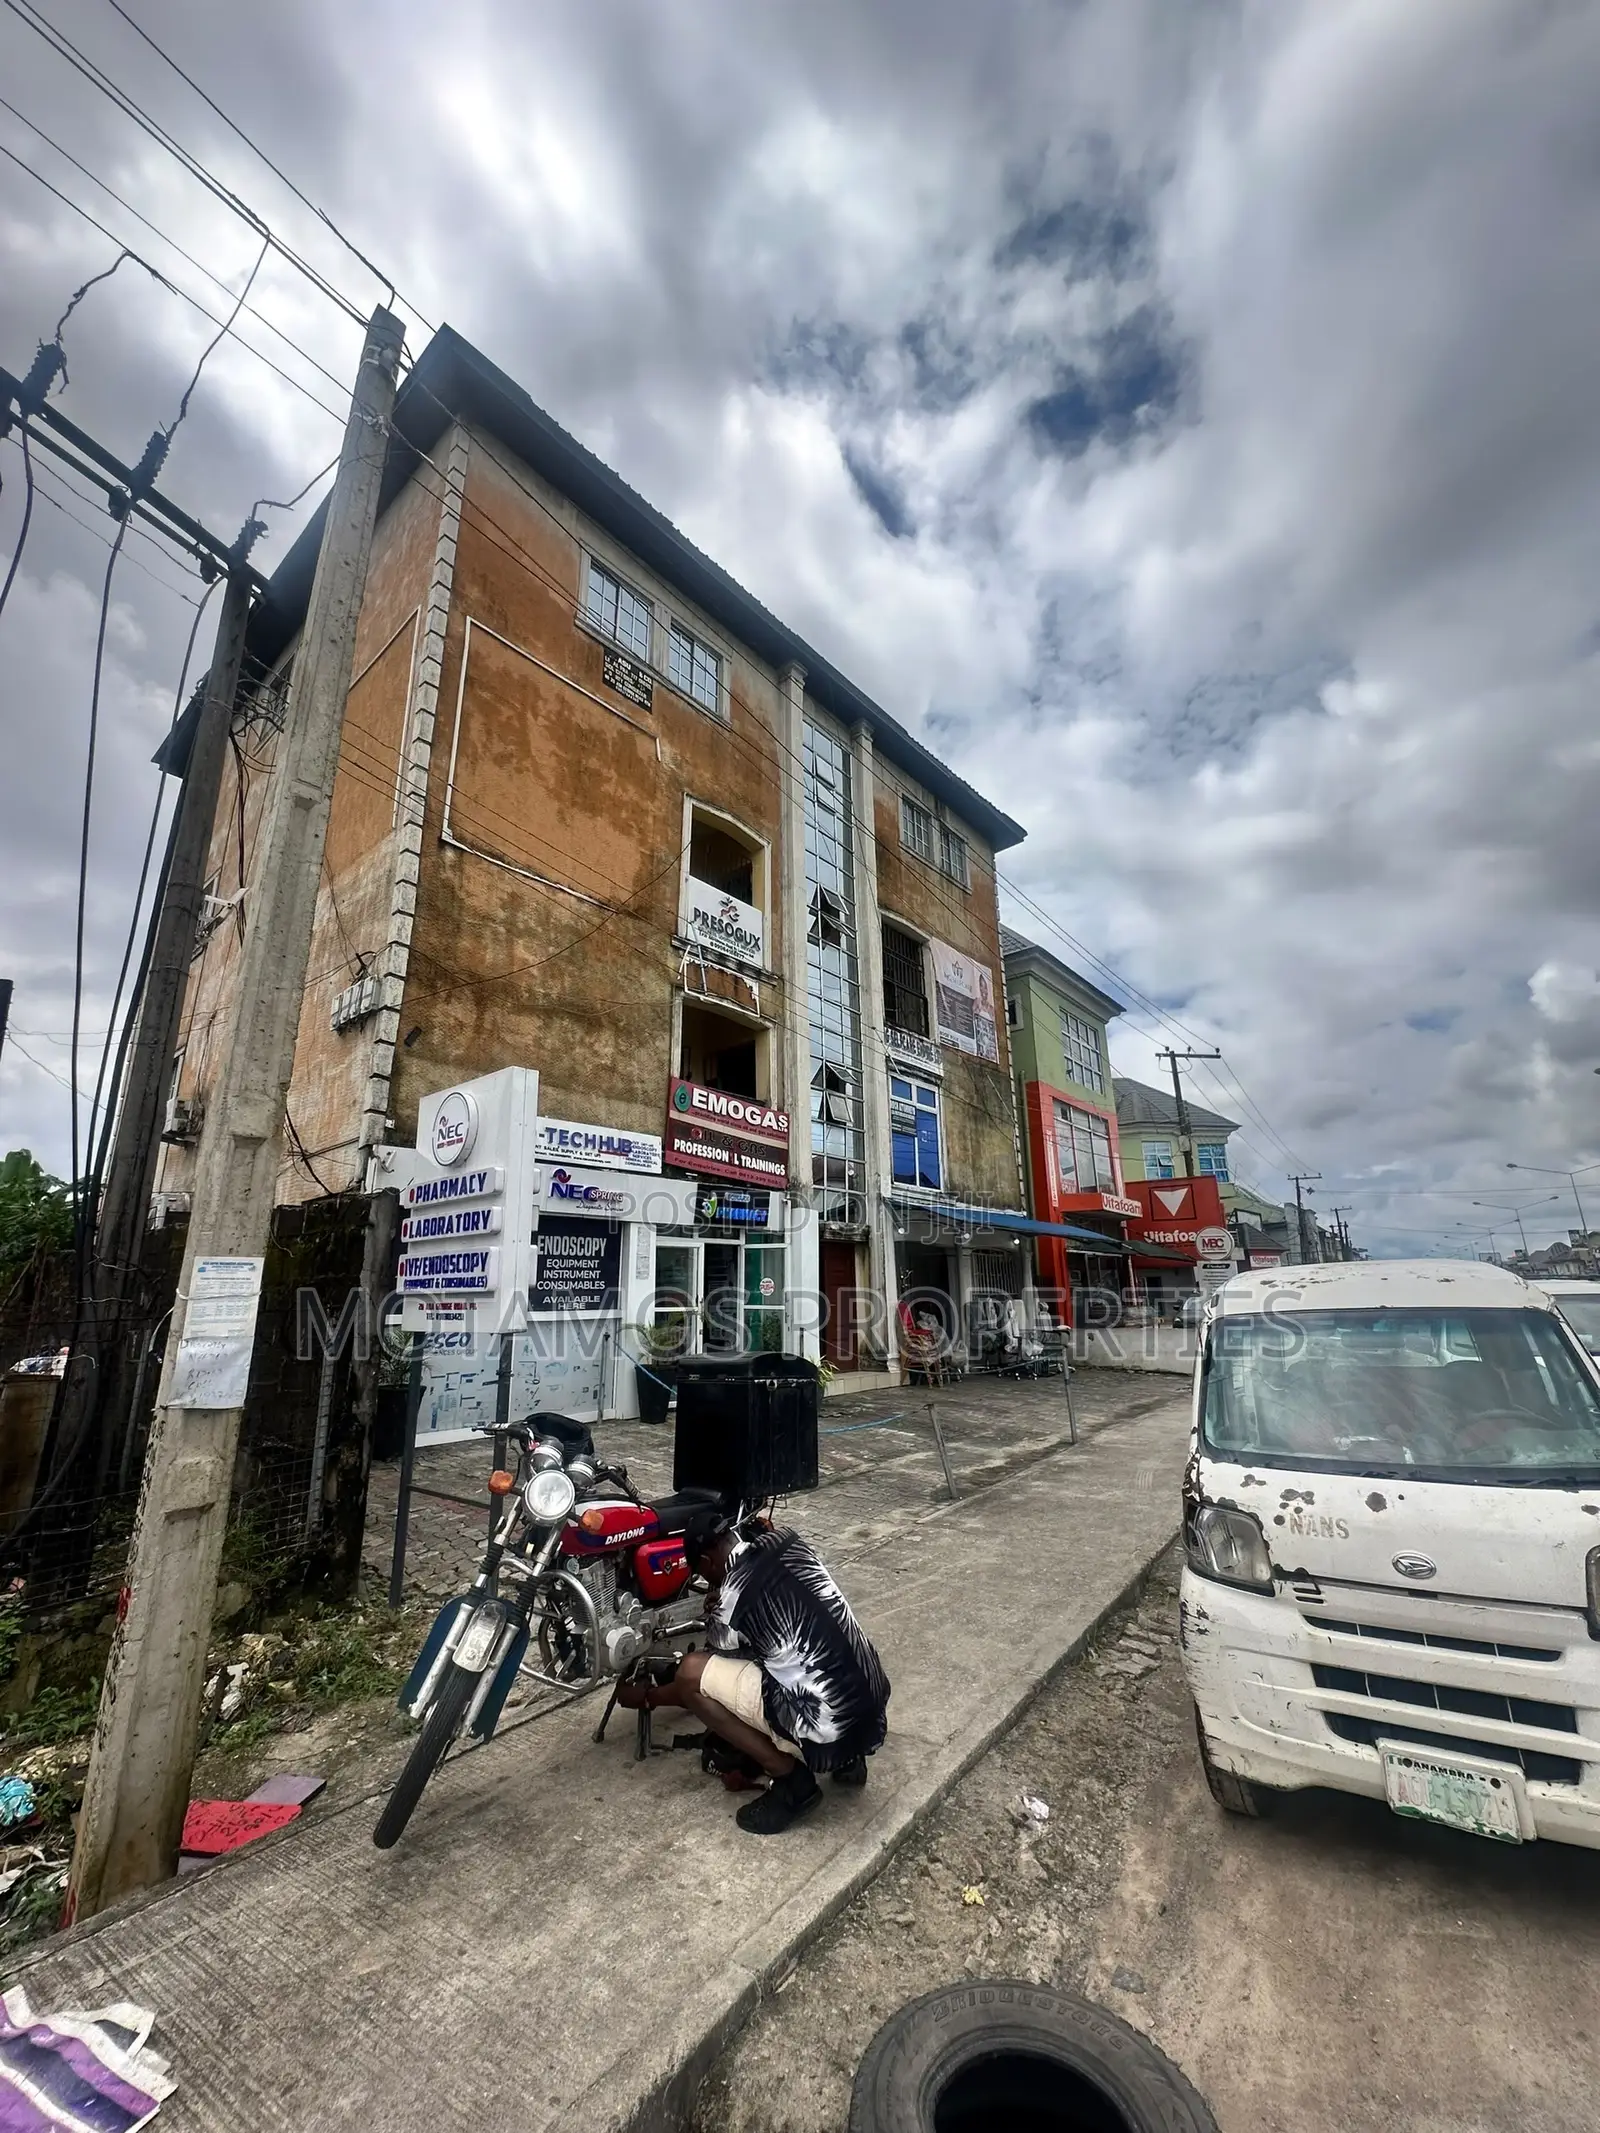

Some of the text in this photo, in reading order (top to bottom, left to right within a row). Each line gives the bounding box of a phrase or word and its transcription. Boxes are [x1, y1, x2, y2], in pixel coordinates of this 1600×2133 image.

[693, 906, 761, 950] PRESOGUX
[692, 1087, 788, 1131] EMOGAS
[438, 1122, 464, 1141] NEC
[741, 1155, 786, 1176] TRAININGS
[415, 1172, 488, 1204] PHARMACY
[550, 1182, 624, 1203] NEC SPRING
[408, 1209, 492, 1239] LABORATORY
[537, 1235, 607, 1257] ENDOSCOPY
[1143, 1229, 1198, 1244] Vitafoa
[1202, 1237, 1225, 1248] MBC
[404, 1251, 489, 1277] IVF/ENDOSCOPY
[546, 1258, 600, 1269] EQUIPMENT
[543, 1269, 601, 1279] INSTRUMENT
[536, 1281, 606, 1290] CONSUMABLES
[542, 1295, 601, 1304] AVAILABLE
[558, 1302, 586, 1310] HERE
[605, 1526, 645, 1545] DAYLONG
[1413, 1761, 1474, 1781] ANAMBRA
